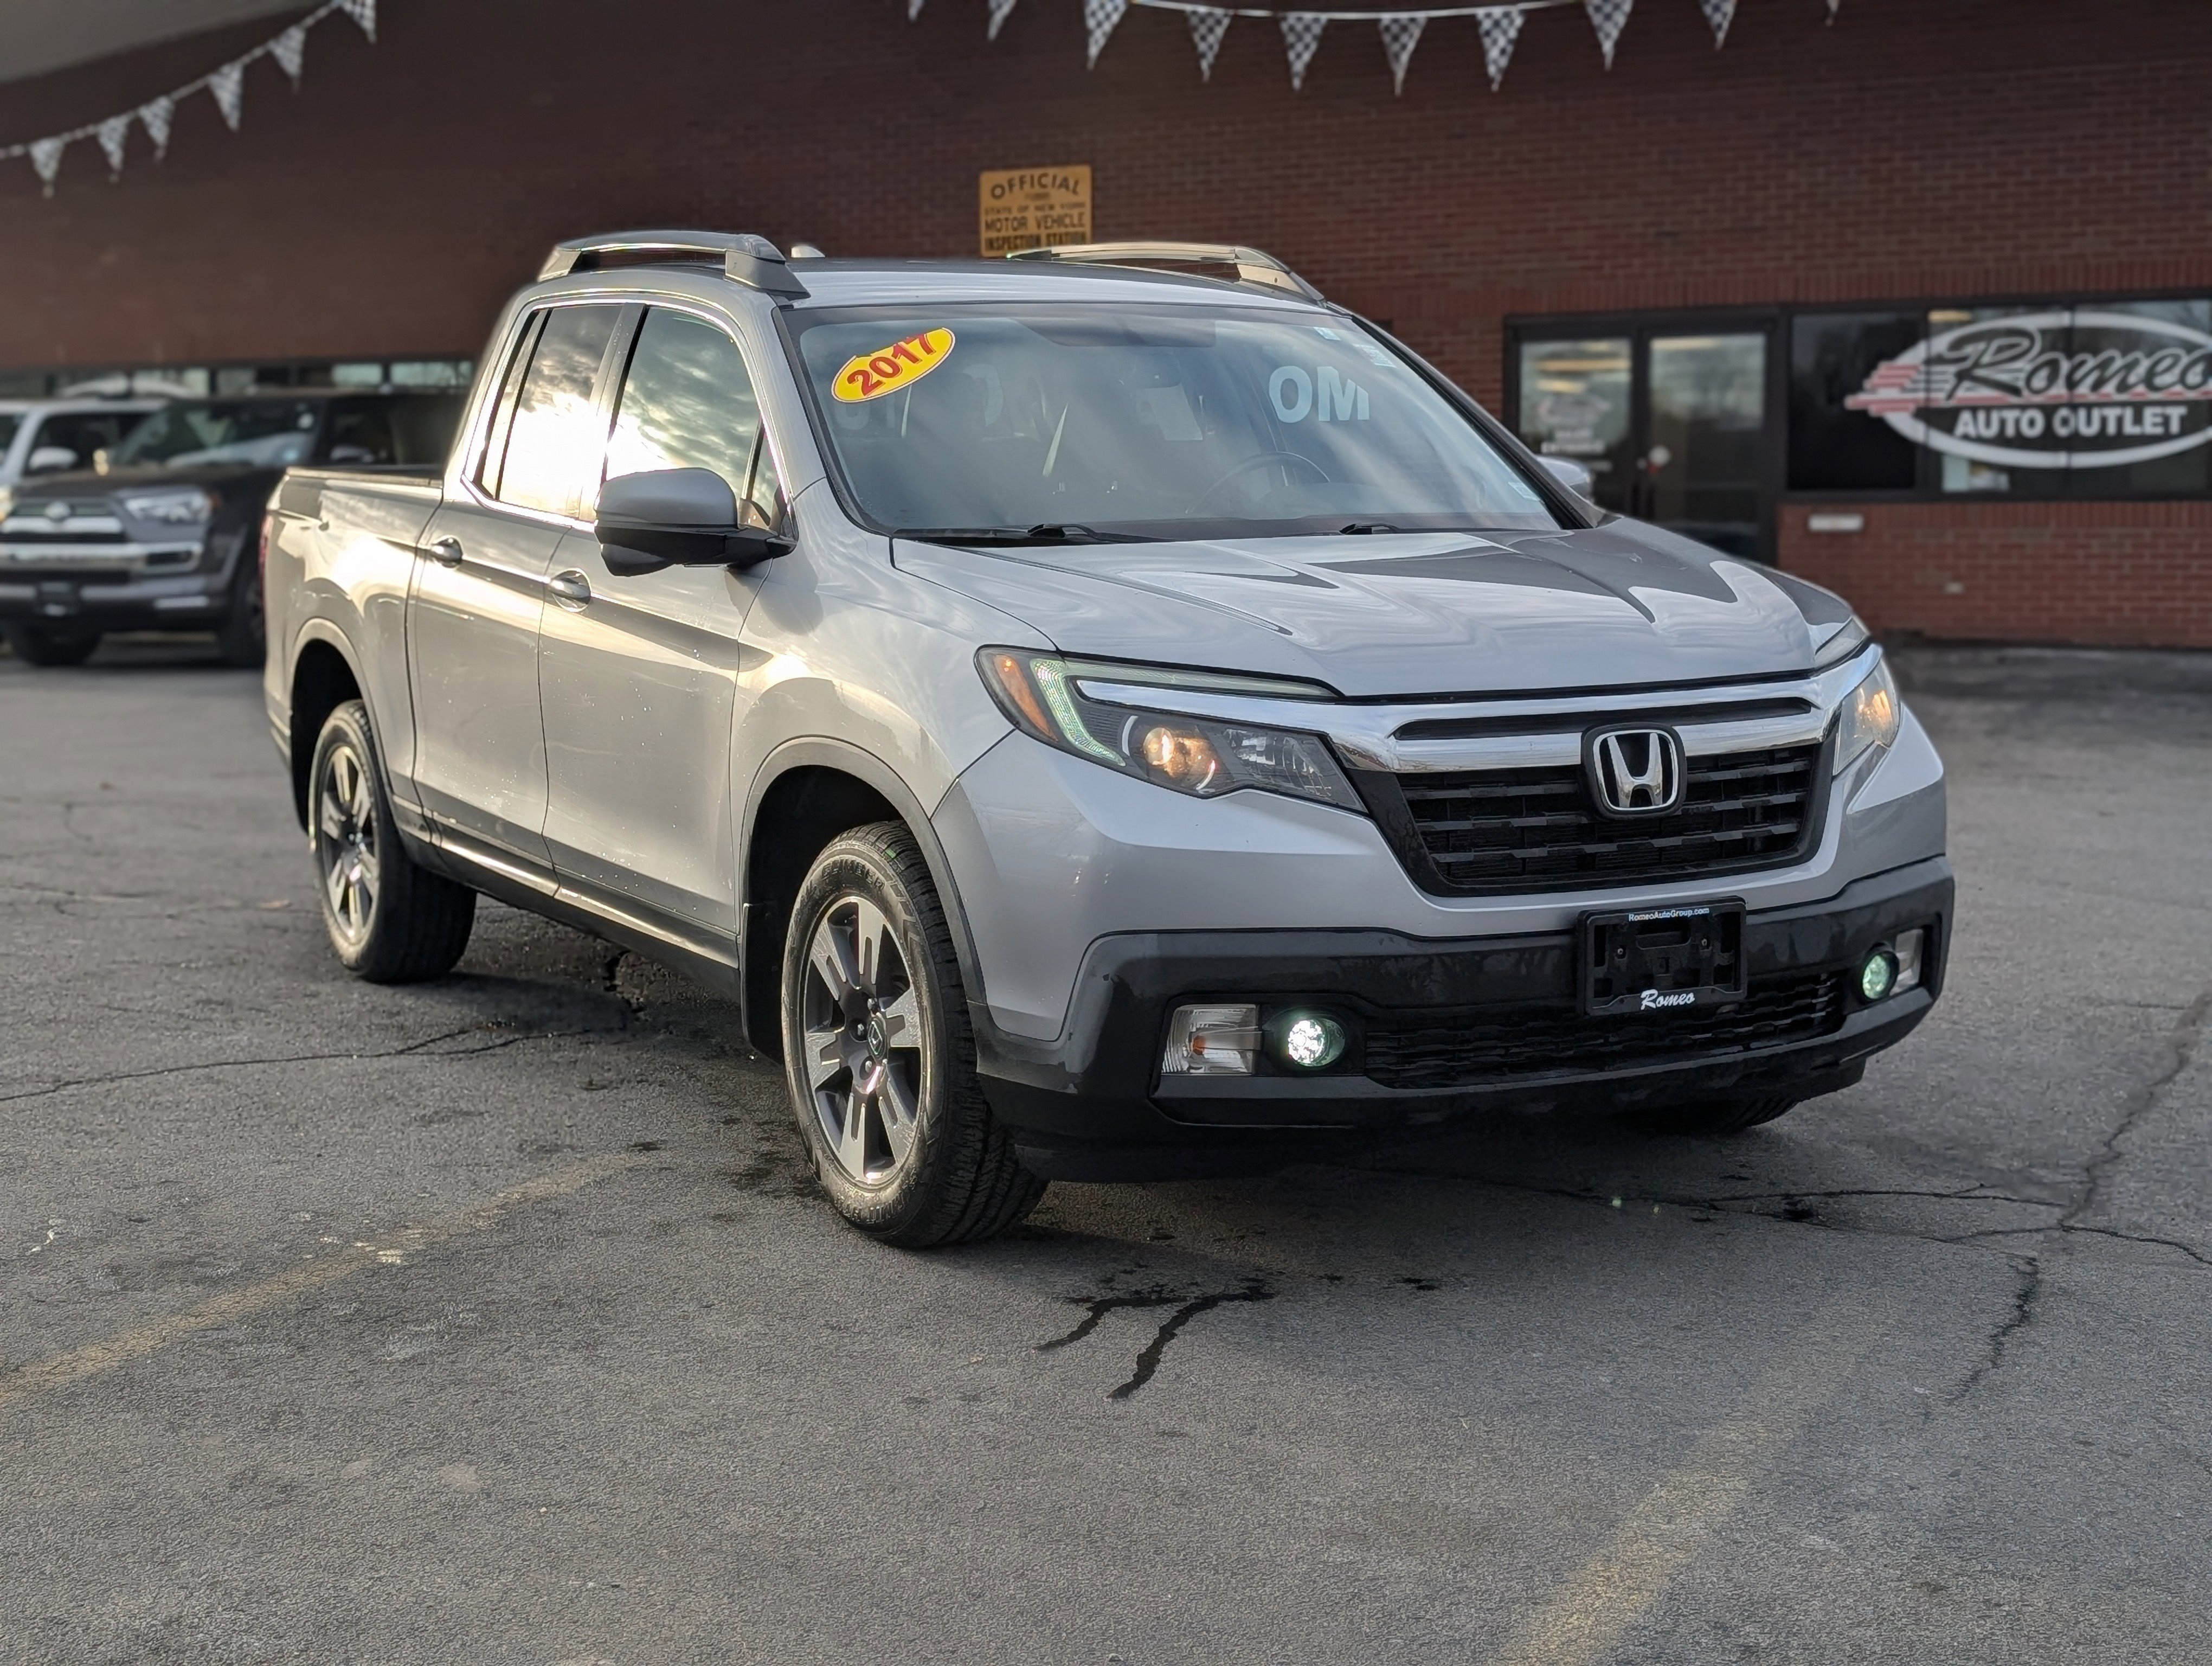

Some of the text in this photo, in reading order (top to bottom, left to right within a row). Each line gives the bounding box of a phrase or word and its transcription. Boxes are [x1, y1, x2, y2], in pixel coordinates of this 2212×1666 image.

[991, 172, 1080, 200] OFFICIAL
[985, 212, 1085, 233] MOTOR VEHICLE
[846, 334, 937, 398] 2017
[1942, 325, 2212, 402] Romeo
[1954, 405, 2188, 440] AUTO OUTLET
[1629, 908, 1710, 922] RomeoAutoGroup.com
[1640, 989, 1695, 1010] Romeo
